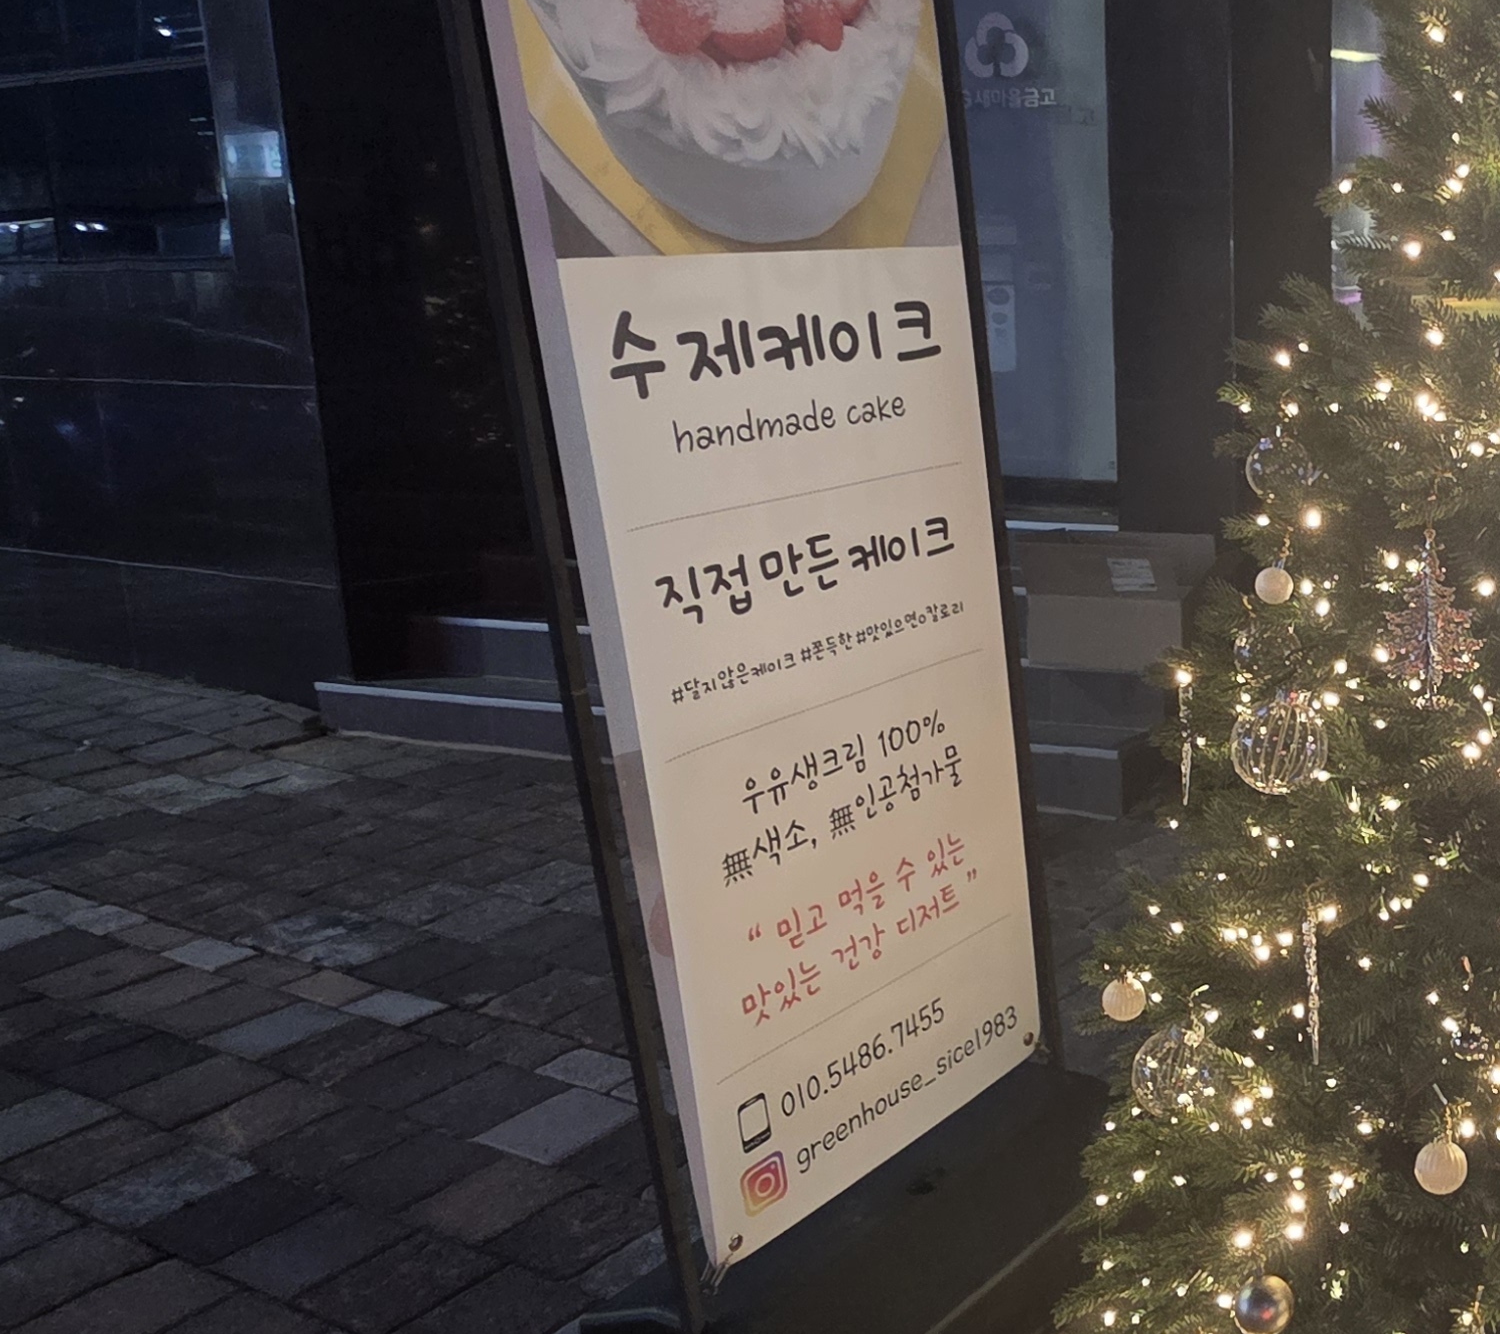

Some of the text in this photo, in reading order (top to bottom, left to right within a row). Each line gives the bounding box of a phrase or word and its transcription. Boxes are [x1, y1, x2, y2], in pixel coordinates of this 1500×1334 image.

[609, 299, 943, 400] 수제케이크
[672, 395, 907, 454] handmade cake
[655, 516, 956, 625] 직접 만든 케이크
[721, 744, 963, 888] 無색소, 無인공첨가물
[742, 708, 946, 815] 우유생크림 100%
[776, 903, 828, 950] 믿고
[837, 870, 886, 916] 먹을
[895, 856, 917, 893] 수
[927, 832, 965, 879] 있는
[741, 960, 822, 1027] 맛있는
[830, 922, 886, 971] 건강
[895, 883, 961, 936] 디저트
[780, 996, 945, 1118] 010.5486.7455
[796, 1004, 1018, 1174] greenhouse_sice1983
